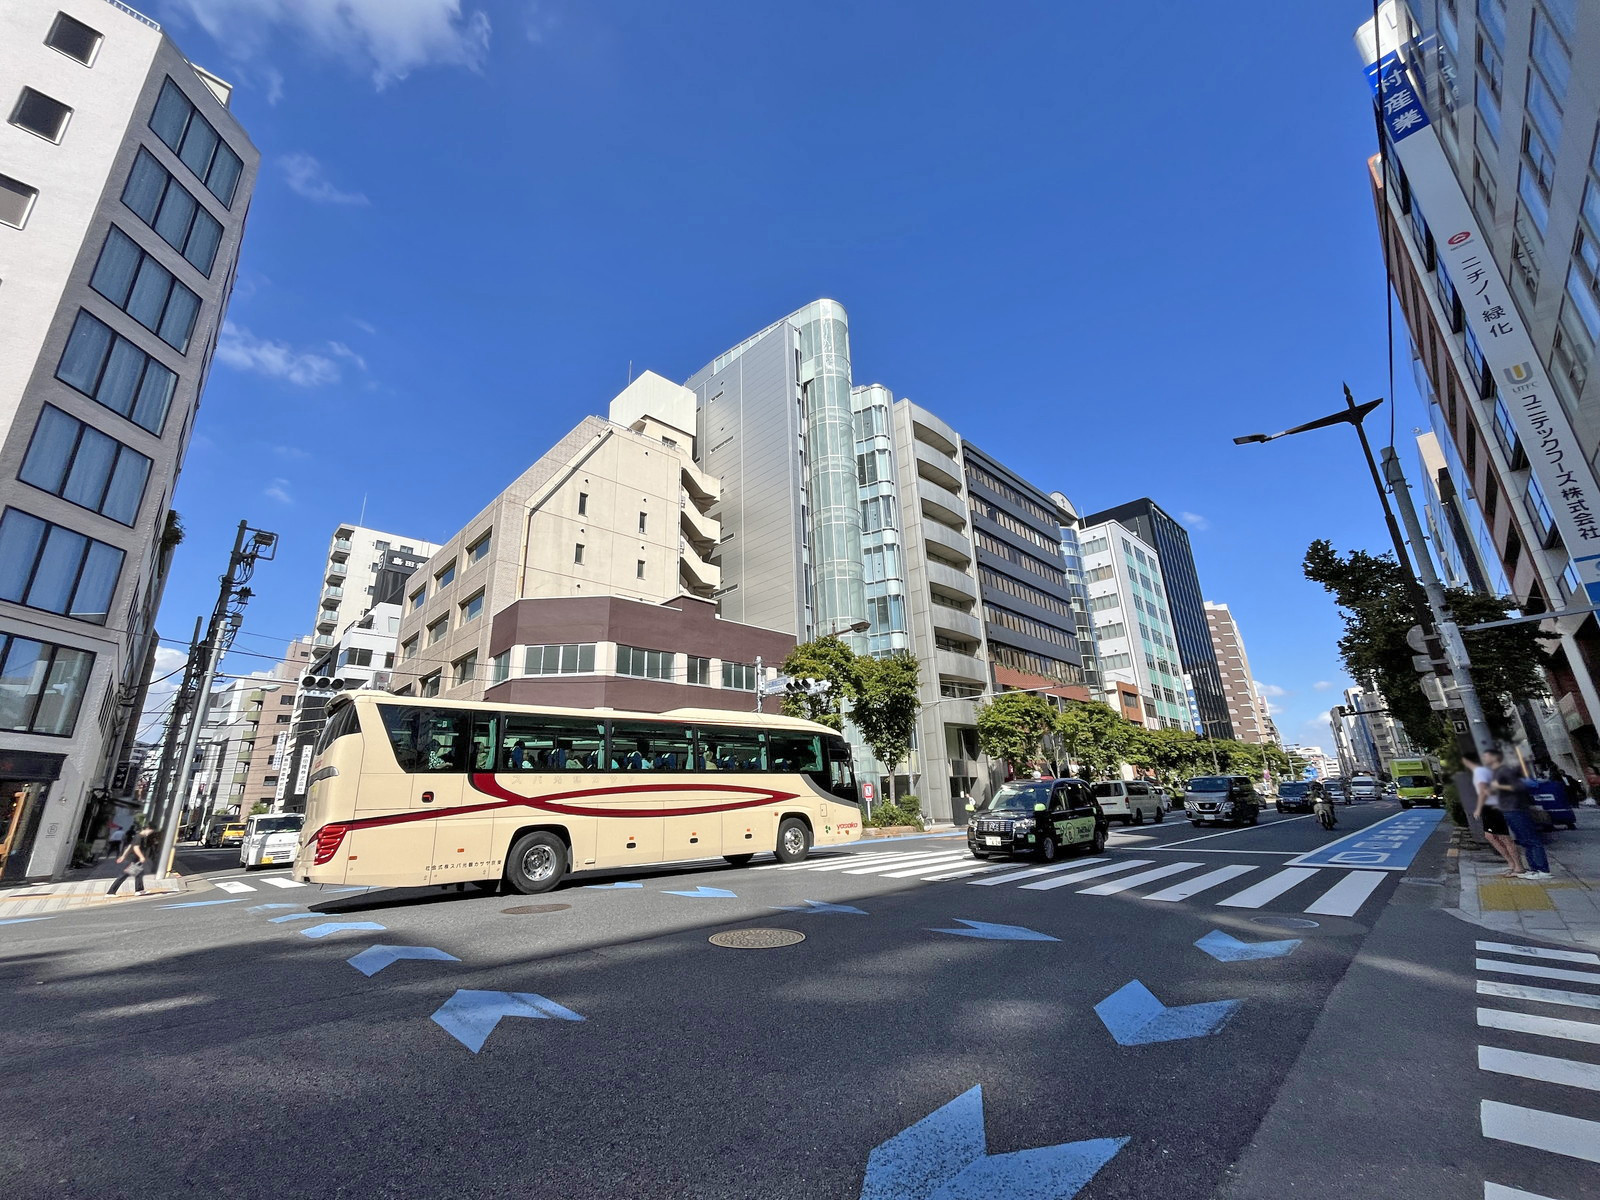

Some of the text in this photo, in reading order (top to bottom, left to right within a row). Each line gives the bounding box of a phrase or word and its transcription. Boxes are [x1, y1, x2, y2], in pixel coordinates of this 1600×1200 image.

[1461, 256, 1513, 338] ニチノー緑化
[1522, 394, 1600, 541] ユニテックフーズ株式会社
